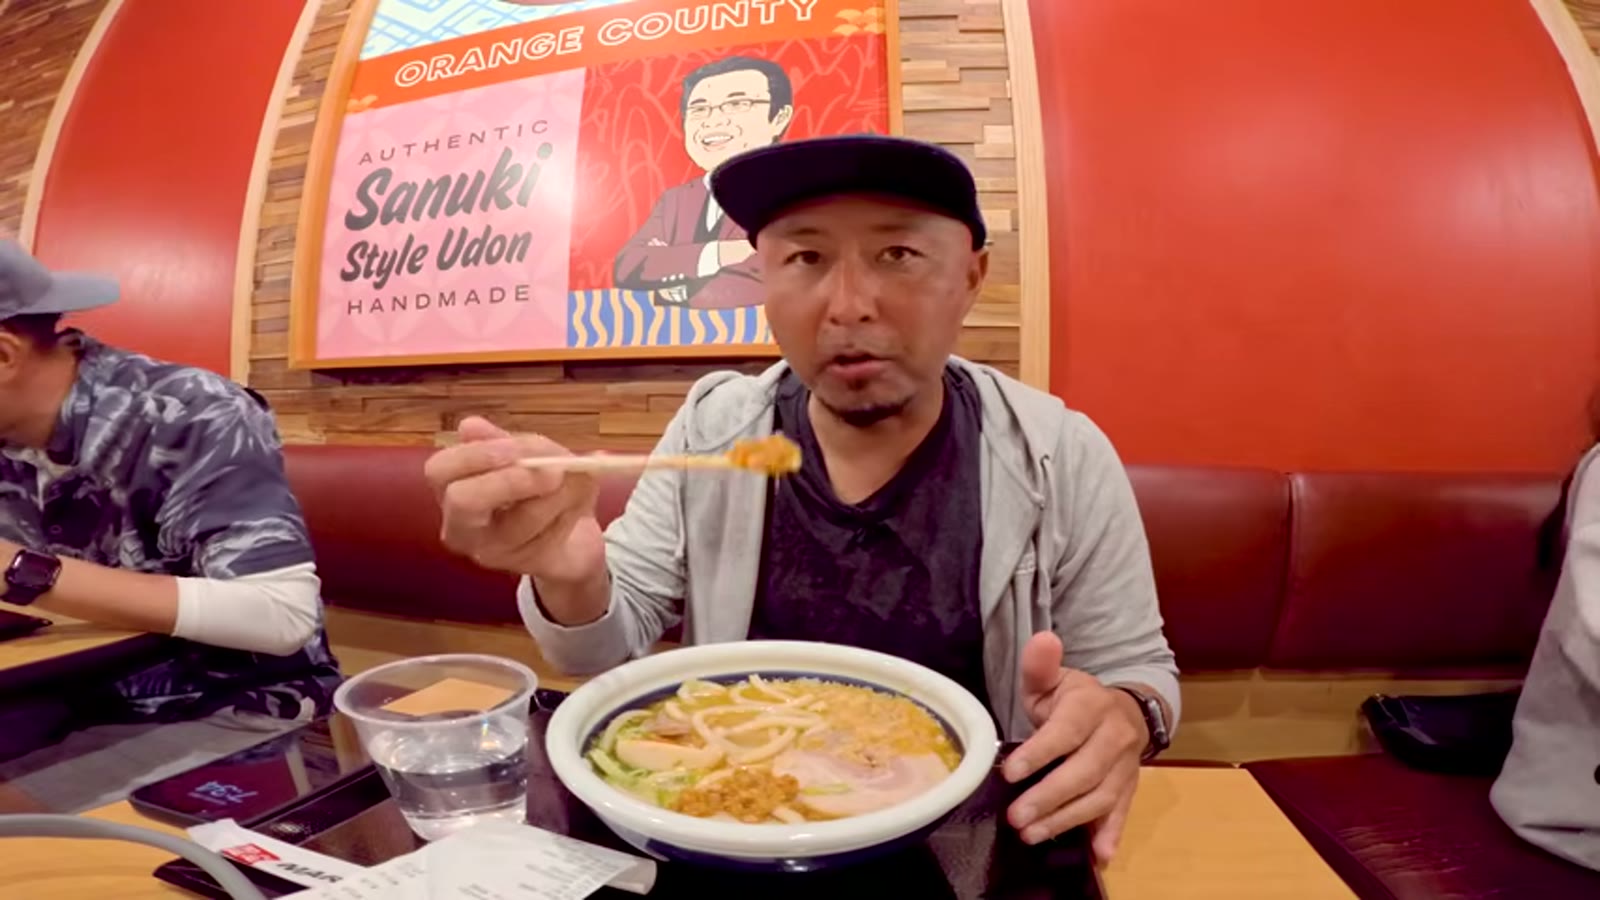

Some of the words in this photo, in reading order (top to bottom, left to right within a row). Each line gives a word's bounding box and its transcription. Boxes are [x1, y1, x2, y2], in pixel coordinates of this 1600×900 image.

[394, 26, 585, 88] ORANGE
[597, 0, 818, 46] COUNTY
[358, 119, 548, 165] AUTHENTIC
[344, 142, 553, 231] Sanuki
[340, 233, 429, 290] Style
[436, 224, 532, 271] Udon
[347, 284, 530, 315] HANDMADE
